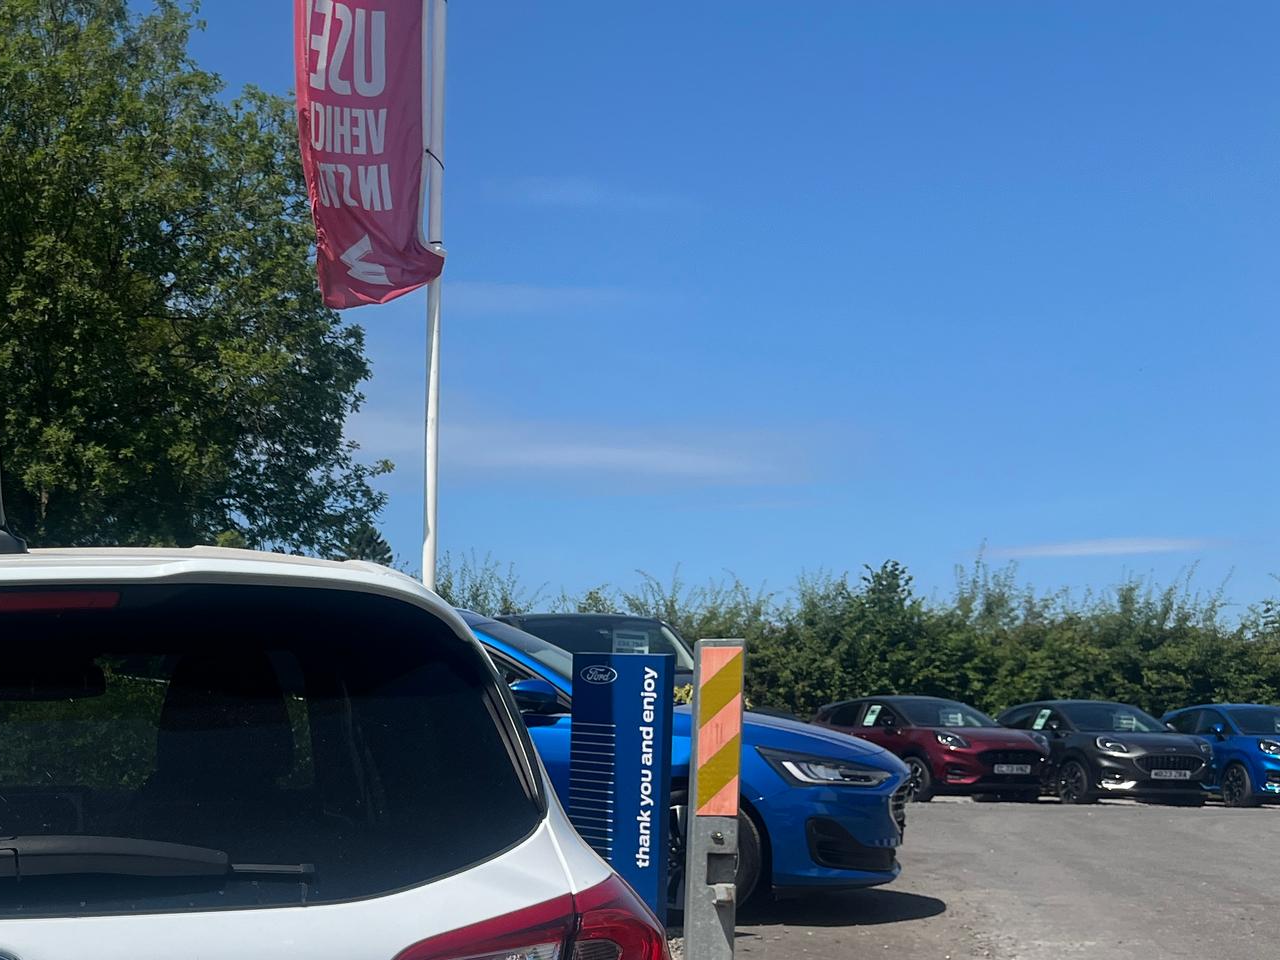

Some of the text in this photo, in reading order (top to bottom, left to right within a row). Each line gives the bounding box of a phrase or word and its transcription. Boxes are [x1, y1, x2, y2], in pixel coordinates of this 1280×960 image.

[585, 667, 611, 682] Ford
[636, 666, 658, 868] thank you and enjoy
